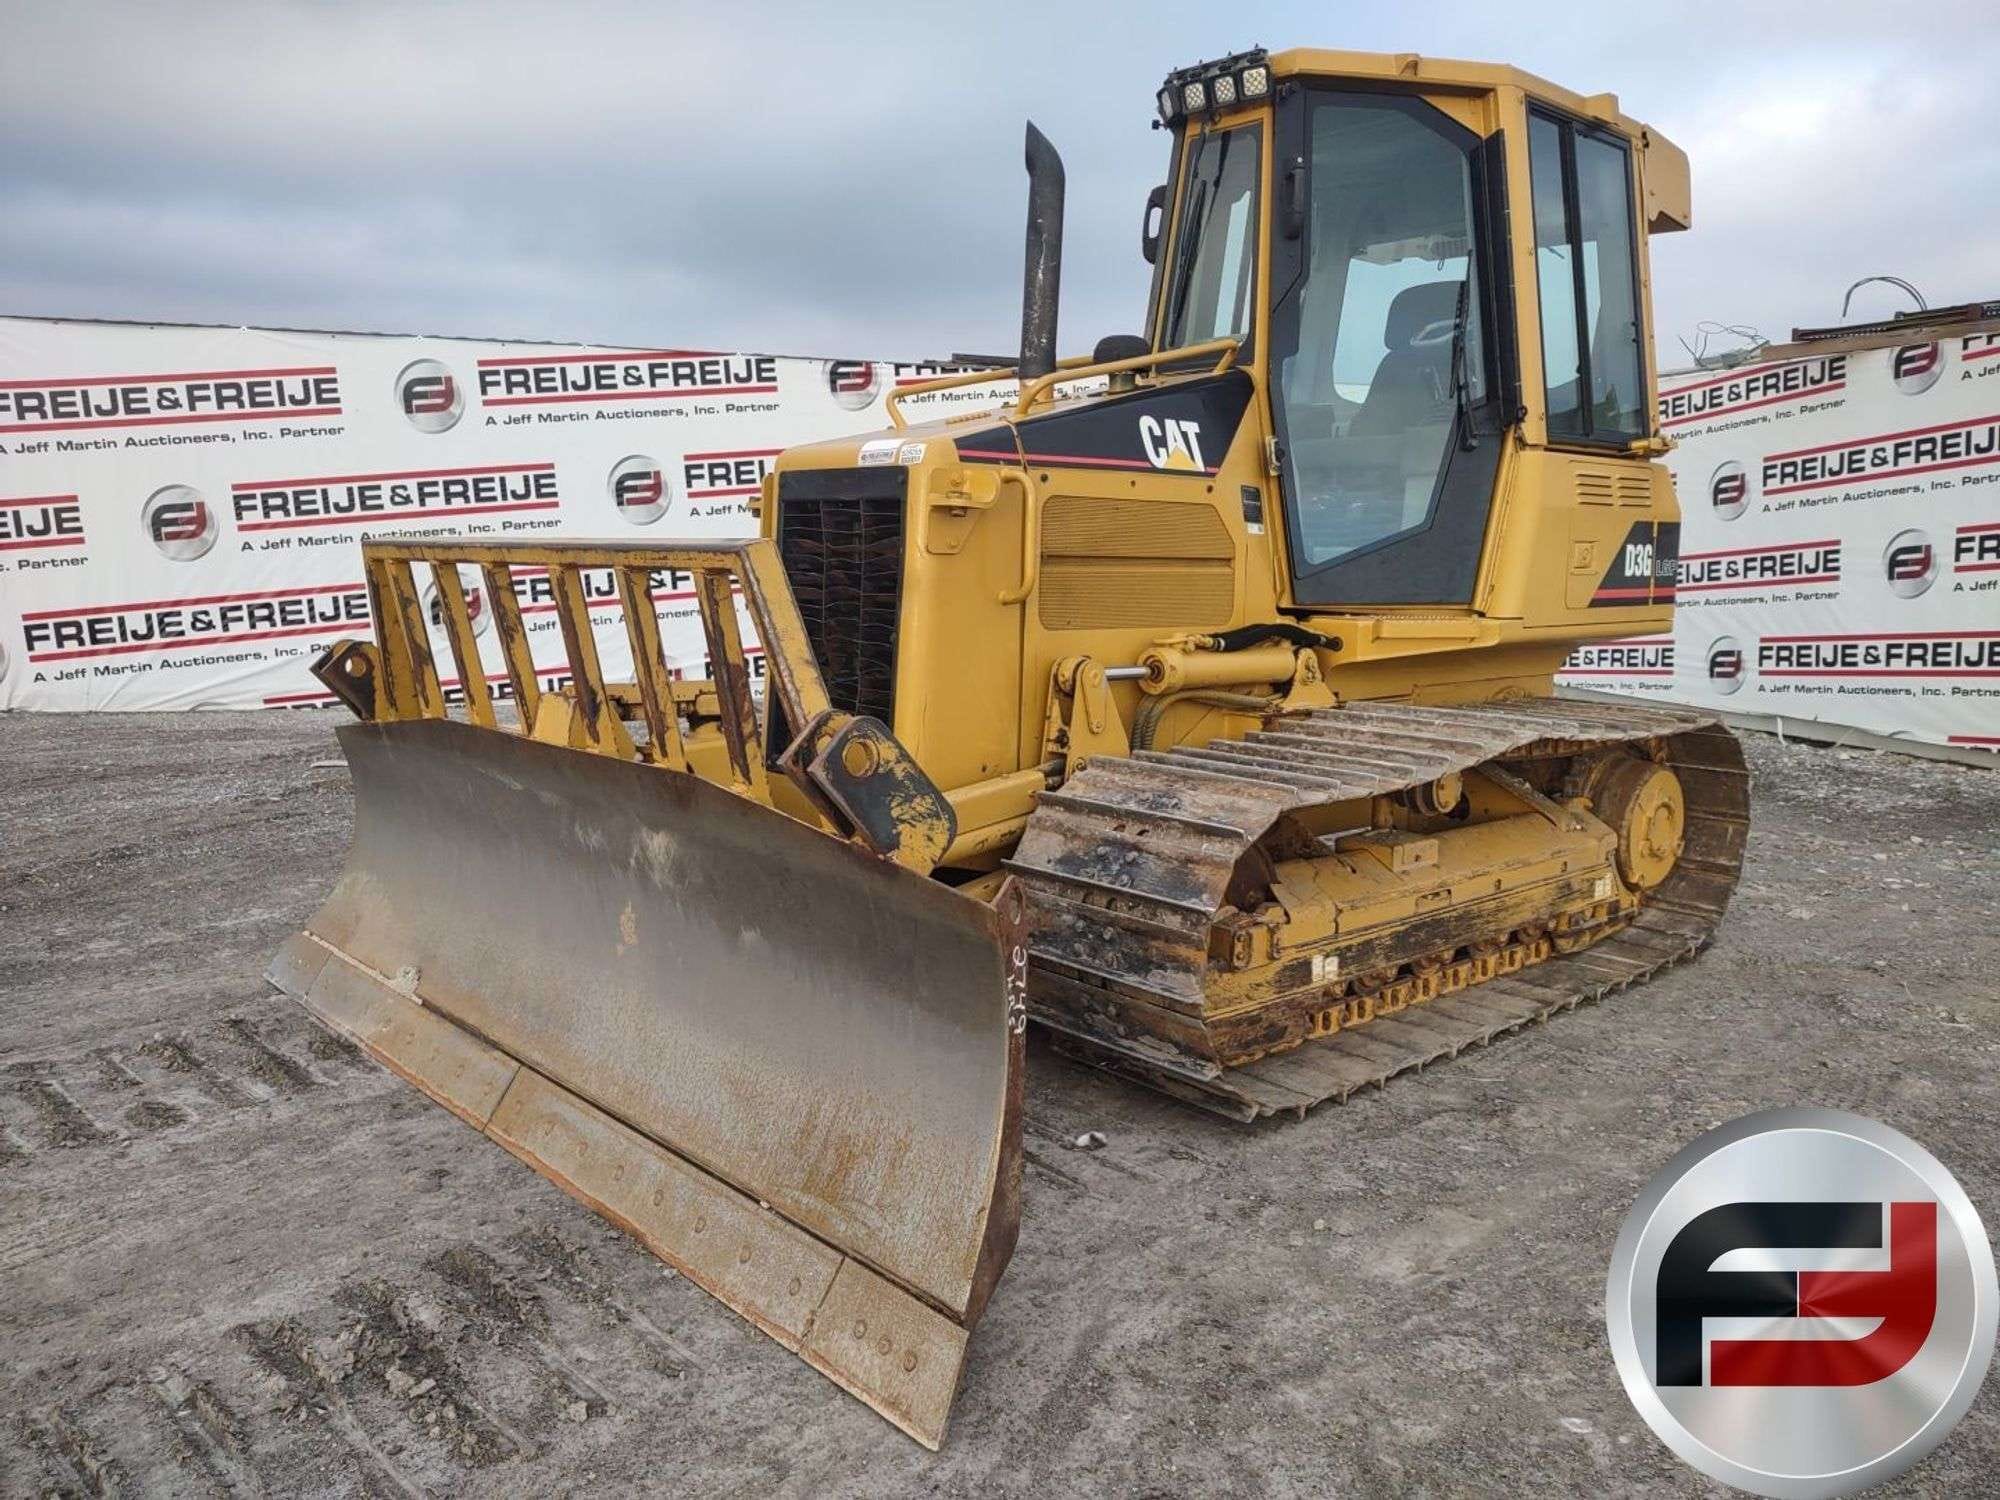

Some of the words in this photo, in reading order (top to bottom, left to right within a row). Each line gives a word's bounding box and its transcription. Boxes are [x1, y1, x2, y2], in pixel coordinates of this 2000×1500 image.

[1961, 371, 1972, 381] A
[912, 394, 937, 405] Jeff
[942, 390, 984, 402] Martin
[485, 416, 497, 426] A
[503, 413, 531, 425] Jeff
[538, 411, 589, 424] Martin
[595, 406, 689, 421] Auctioneers,
[694, 404, 720, 416] Inc.
[725, 401, 781, 414] Partner
[1670, 429, 1702, 441] Martin
[1706, 415, 1771, 434] Auctioneers,
[1776, 410, 1796, 419] Inc.
[1800, 399, 1846, 415] Partner
[15, 442, 50, 454] Jeff
[56, 437, 118, 453] Martin
[125, 431, 237, 448] Auctioneers,
[243, 429, 274, 441] Inc.
[280, 426, 345, 439] Partner
[1138, 414, 1206, 473] CAT
[1762, 503, 1771, 513] A
[1774, 501, 1795, 512] Jeff
[1798, 495, 1839, 509] Martin
[1843, 483, 1926, 502] Auctioneers,
[1931, 480, 1956, 490] Inc.
[690, 507, 701, 517] A
[706, 503, 732, 516] Jeff
[241, 541, 254, 552] A
[260, 538, 291, 551] Jeff
[298, 534, 354, 547] Martin
[468, 523, 496, 534] Inc.
[502, 518, 562, 532] Partner
[18, 556, 89, 570] Partner
[1624, 543, 1653, 577] D3G
[1953, 582, 1964, 592] A
[1969, 580, 1998, 591] Jeff
[1704, 595, 1769, 607] Auctioneers,
[1772, 593, 1792, 602] Inc.
[1795, 591, 1840, 602] Partner
[528, 620, 557, 632] Jeff
[33, 672, 48, 683] A
[54, 667, 88, 682] Jeff
[94, 661, 153, 677] Martin
[160, 652, 269, 670] Auctioneers,
[274, 646, 305, 658] Inc.
[1770, 683, 1791, 693] Jeff
[1793, 684, 1834, 695] Martin
[1837, 685, 1916, 697] Auctioneers,
[1921, 686, 1946, 696] Inc.
